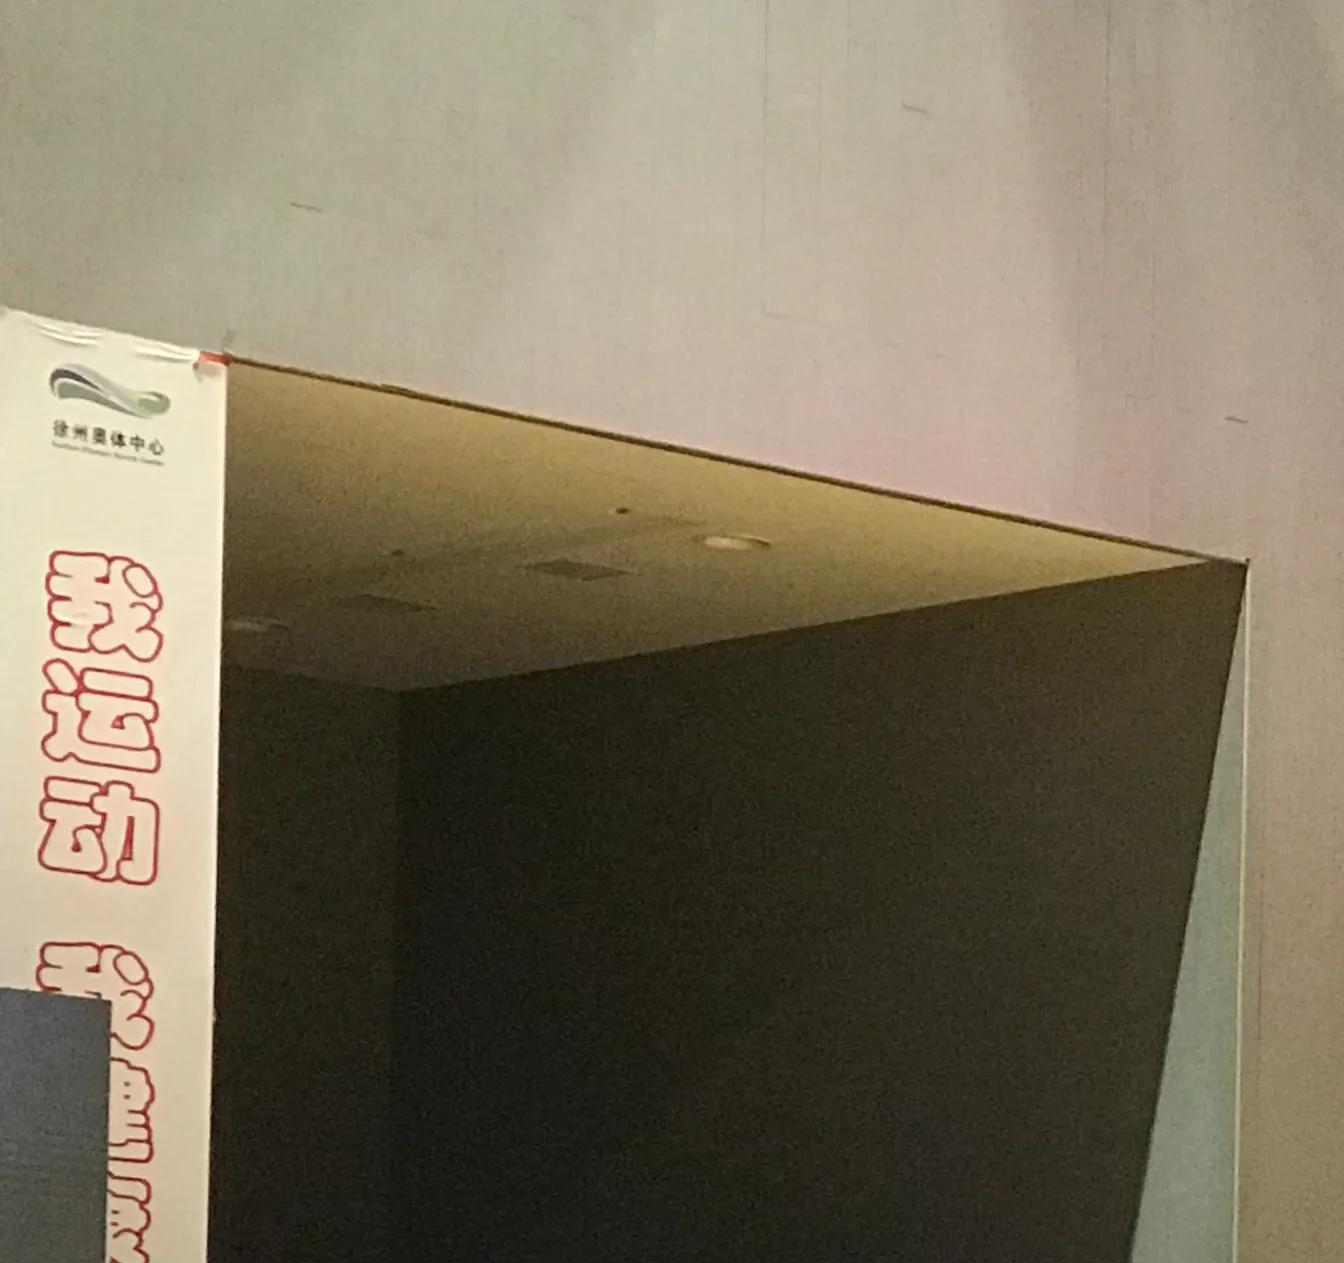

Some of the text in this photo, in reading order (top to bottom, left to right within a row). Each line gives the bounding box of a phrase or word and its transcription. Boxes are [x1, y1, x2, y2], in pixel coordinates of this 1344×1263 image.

[52, 418, 166, 457] 徐州奥体中心
[38, 549, 164, 887] 我运动
